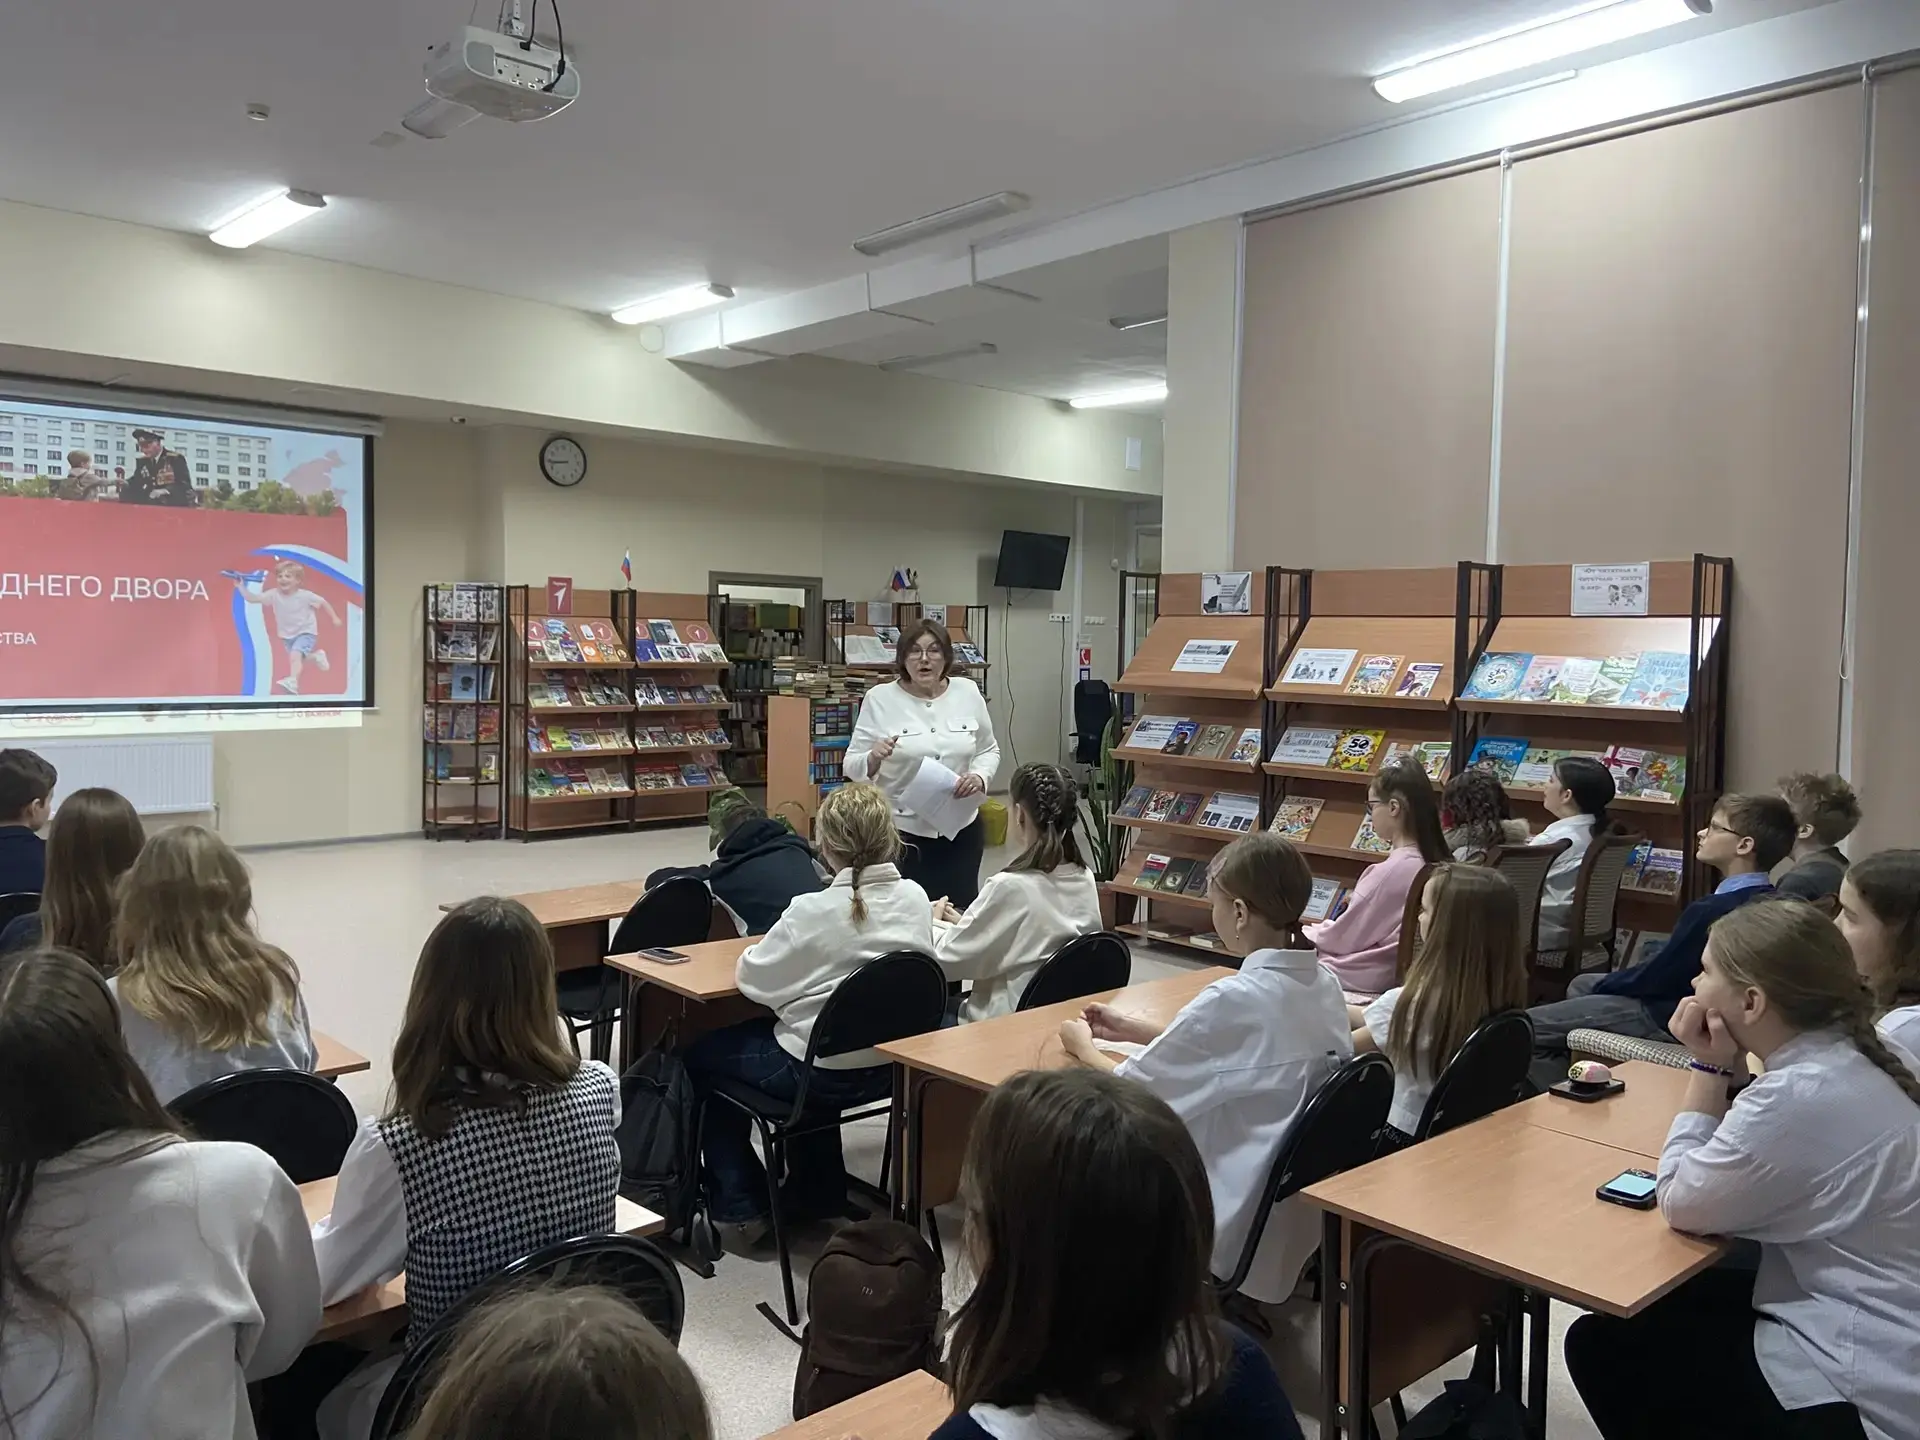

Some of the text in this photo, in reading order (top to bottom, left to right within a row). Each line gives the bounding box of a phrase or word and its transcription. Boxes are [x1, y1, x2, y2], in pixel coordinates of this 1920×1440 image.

[0, 573, 209, 602] ДНЕГО ДВОРА
[0, 631, 37, 645] ТВА
[1348, 738, 1370, 750] 50
